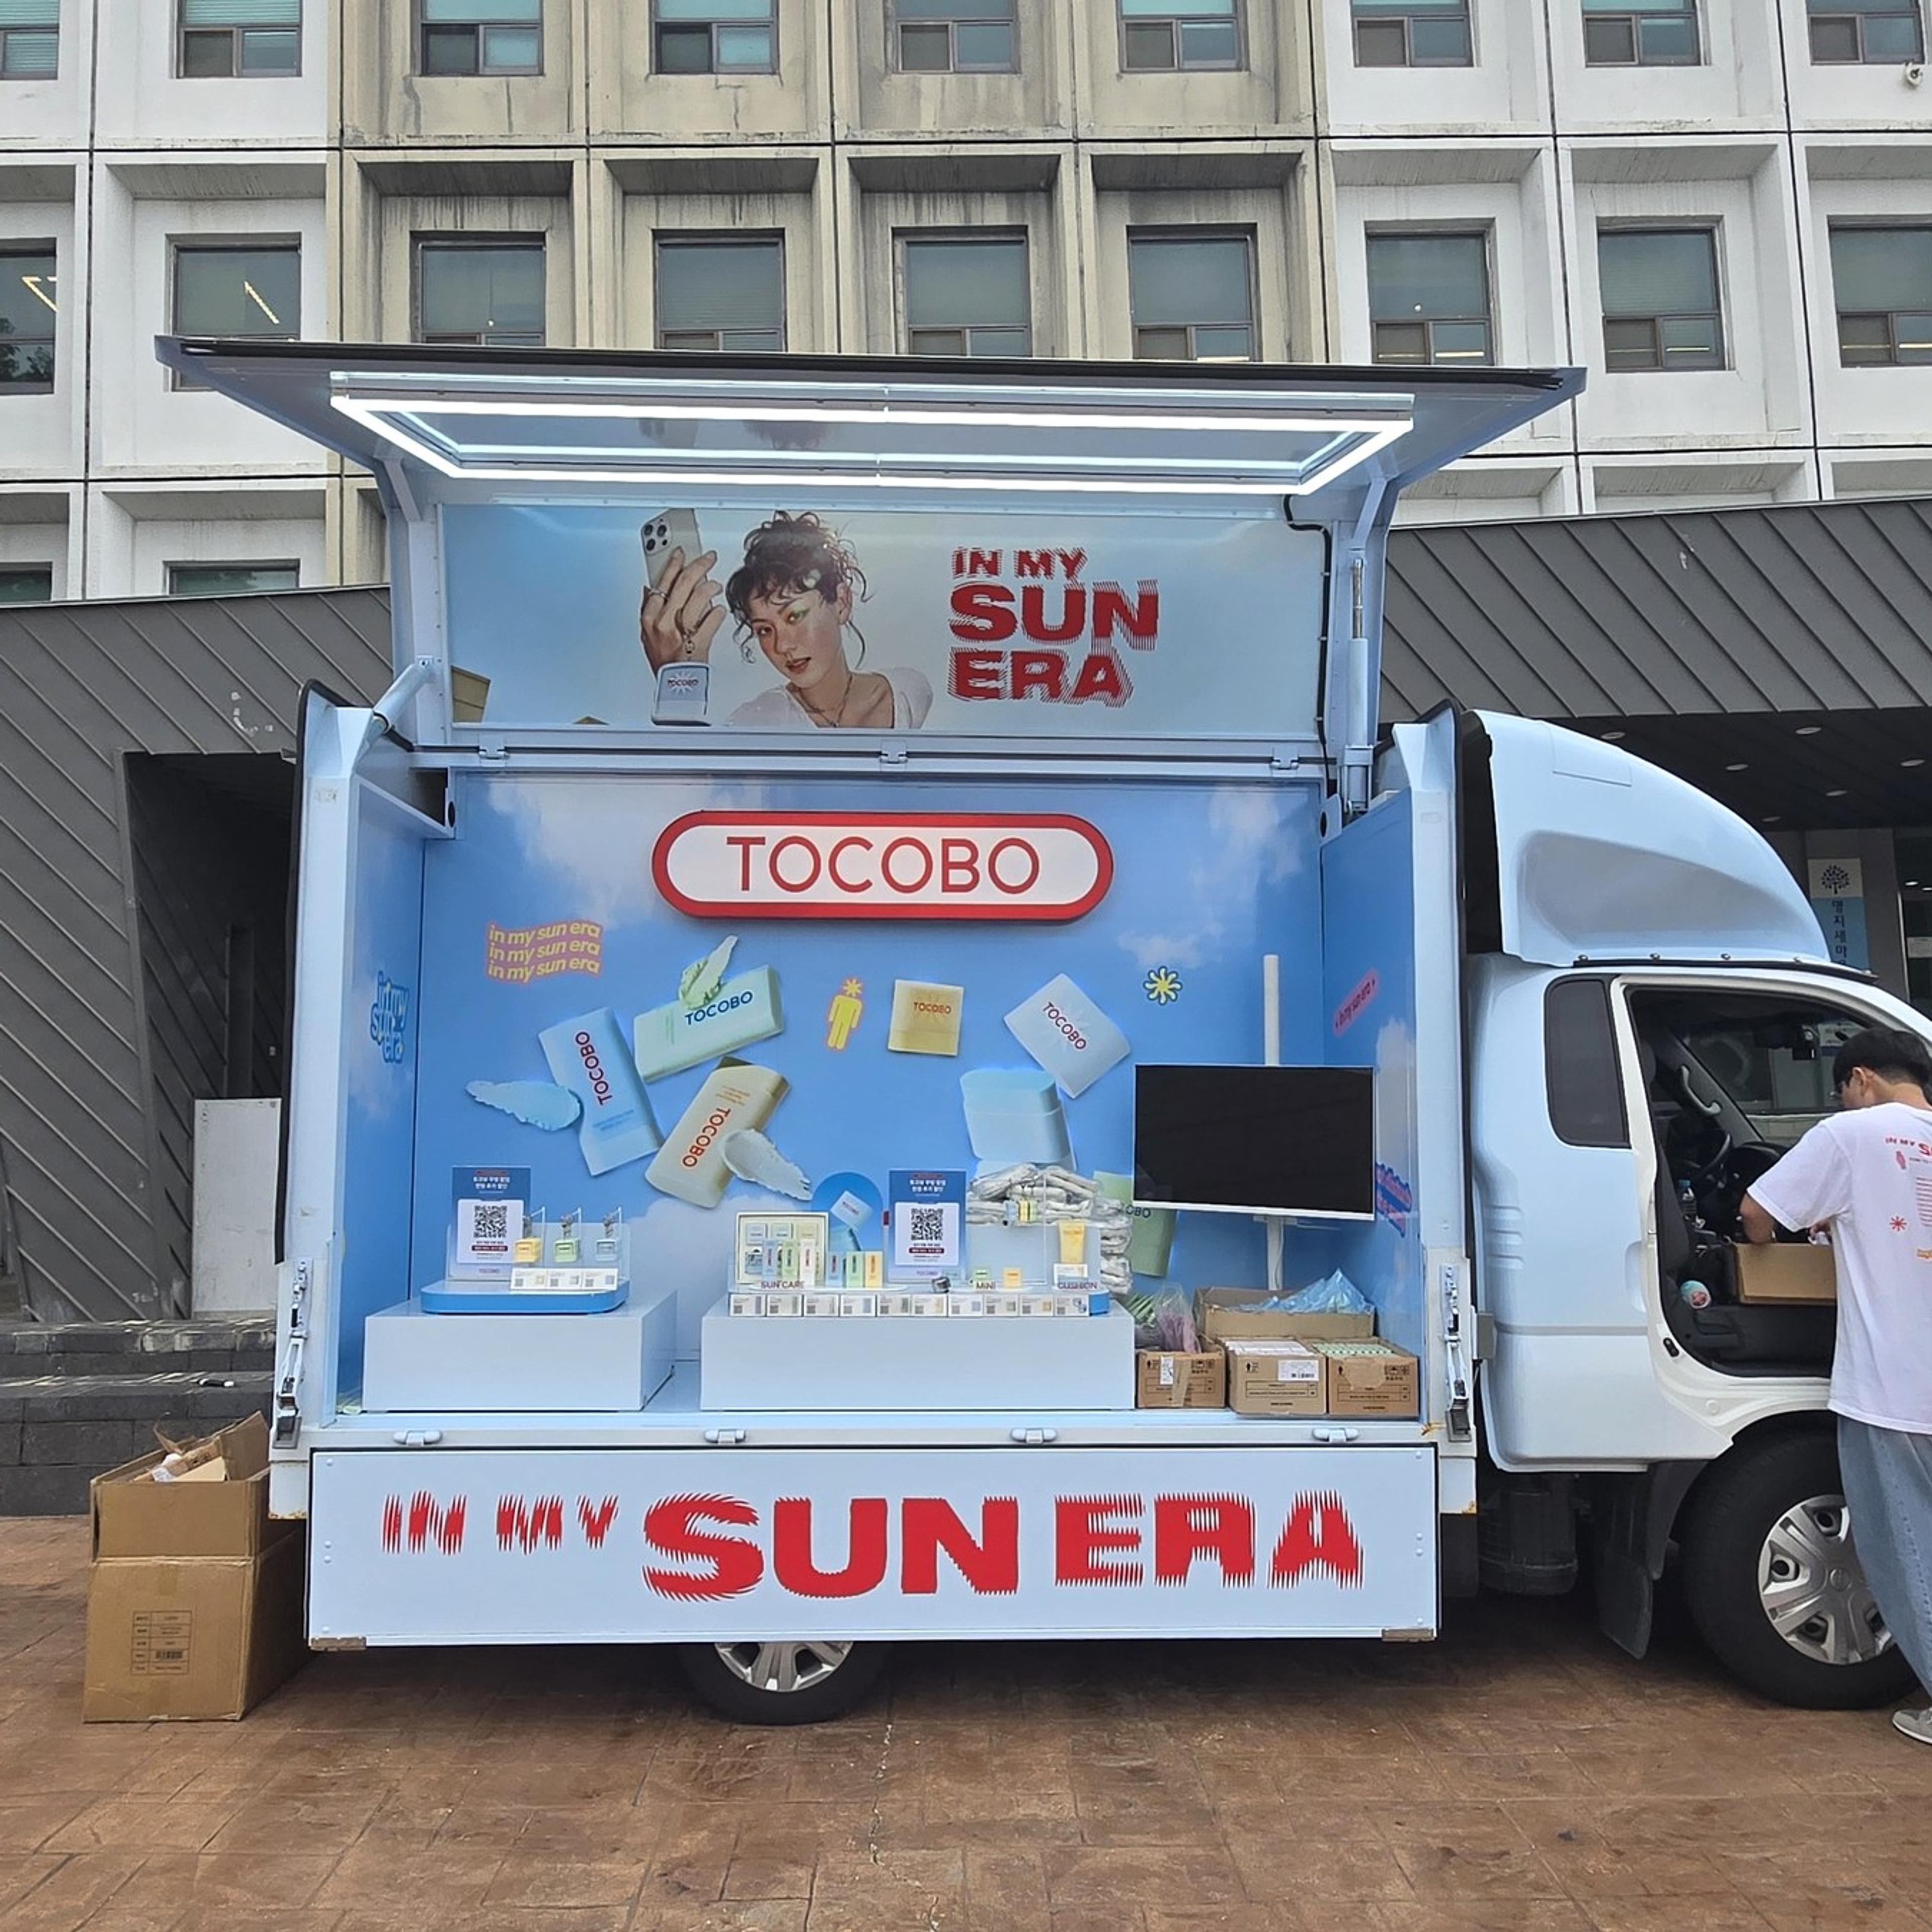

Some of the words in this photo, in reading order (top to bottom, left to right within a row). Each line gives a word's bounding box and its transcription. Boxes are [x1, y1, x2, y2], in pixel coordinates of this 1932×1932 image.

[951, 547, 1002, 579] IN
[1013, 547, 1087, 582] MY
[949, 580, 1158, 650] SUN
[947, 648, 1133, 707] ERA
[727, 836, 1039, 895] TOCOBO
[489, 942, 504, 961] in
[507, 948, 535, 964] my
[536, 940, 567, 958] sun
[570, 940, 600, 955] era
[490, 925, 504, 943] in
[508, 930, 535, 947] my
[537, 923, 567, 940] sun
[570, 922, 600, 938] era
[489, 960, 504, 979] in
[507, 965, 534, 983] my
[536, 958, 566, 975] sun
[570, 957, 600, 974] era
[685, 991, 753, 1025] TOCOBO
[913, 1002, 951, 1014] TOCOBO
[1042, 1001, 1086, 1050] TOCOBO
[575, 1031, 612, 1105] TOCOBO
[682, 1107, 731, 1167] TOCOBO
[381, 1490, 467, 1556] IN
[496, 1493, 619, 1556] MY
[642, 1492, 1019, 1601] SUN
[1054, 1489, 1365, 1589] ERA
